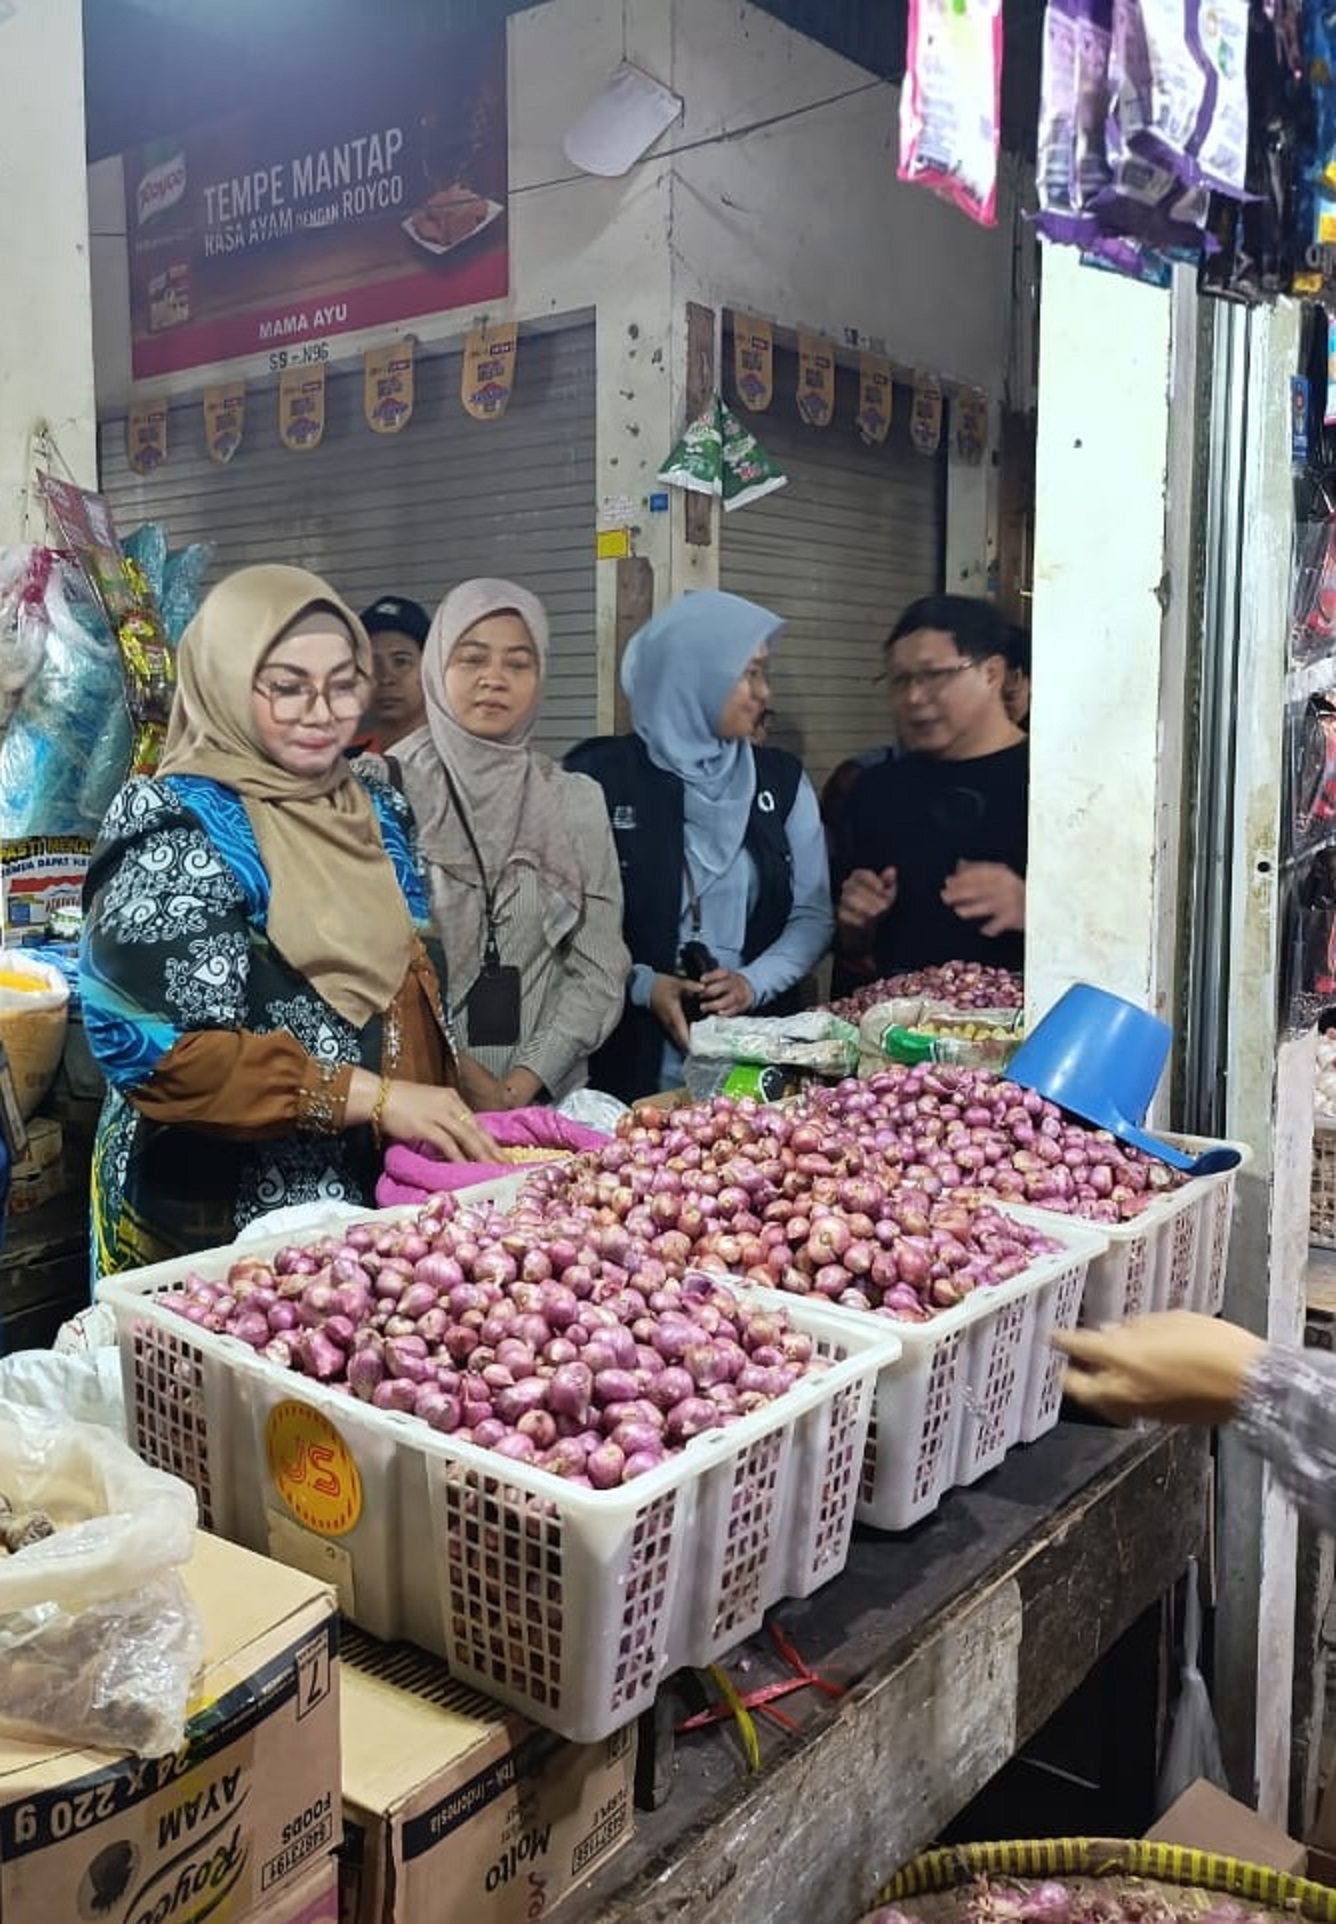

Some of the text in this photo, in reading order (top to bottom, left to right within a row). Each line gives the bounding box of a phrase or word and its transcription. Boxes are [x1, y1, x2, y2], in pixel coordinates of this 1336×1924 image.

[204, 127, 403, 225] TEMPE MANTAP
[205, 225, 246, 257] RASA
[248, 207, 293, 245] AYAM
[342, 175, 403, 217] ROYCO
[259, 303, 348, 340] MAMA AYU
[13, 1804, 37, 1844] g
[50, 1780, 115, 1838] 220
[157, 1766, 241, 1850] AYAM
[281, 1792, 332, 1844] FOODS
[485, 1823, 552, 1892] Molto
